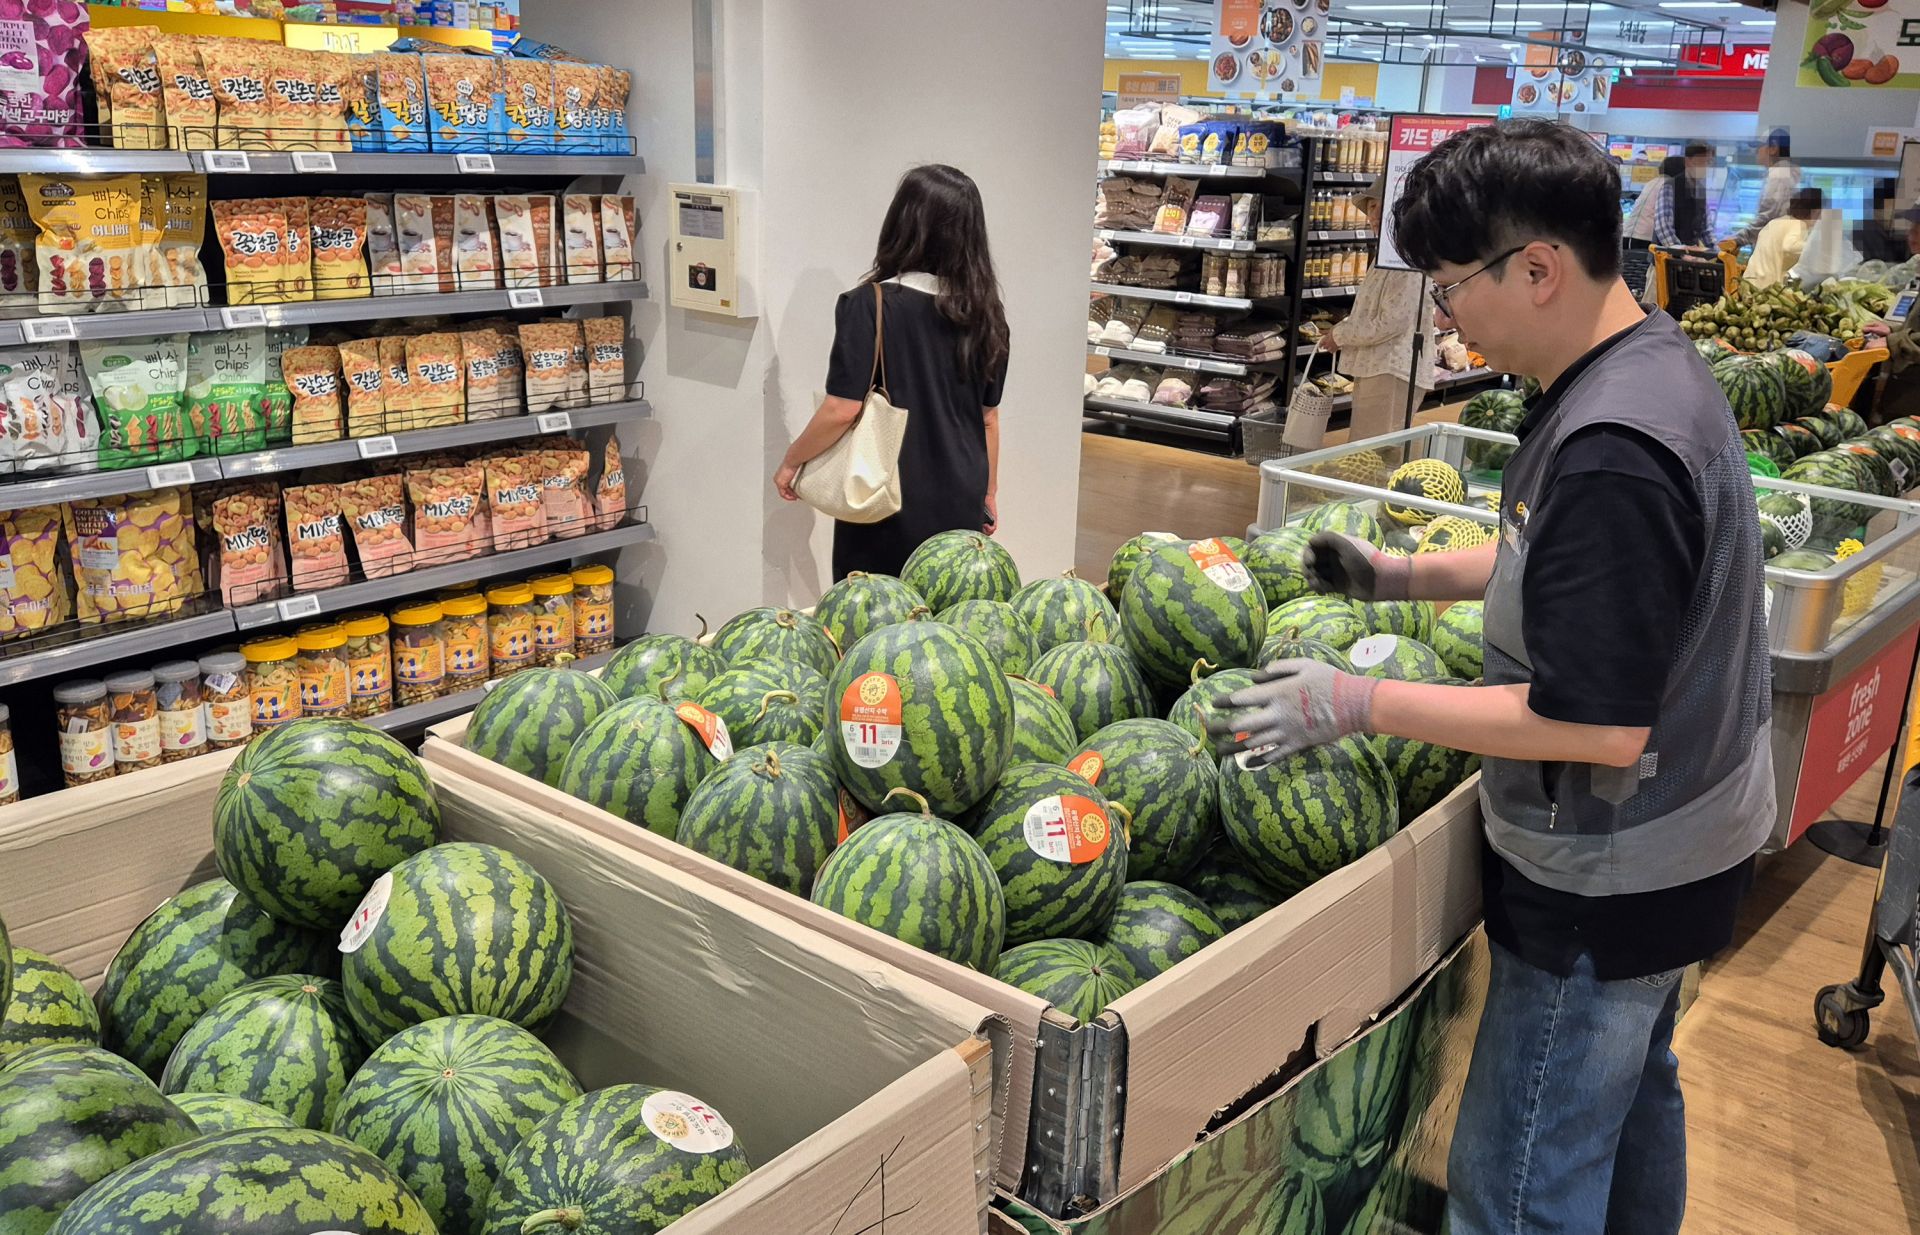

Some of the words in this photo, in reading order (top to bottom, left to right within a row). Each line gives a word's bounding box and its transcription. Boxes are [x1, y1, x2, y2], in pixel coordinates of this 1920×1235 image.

[222, 77, 265, 100] 칼몬드
[275, 79, 317, 103] 칼몬드
[434, 100, 488, 126] 칼땅콩
[505, 103, 549, 128] 칼땅콩
[1400, 127, 1428, 146] 카드
[92, 187, 131, 207] 빠삭
[95, 207, 129, 223] Chips
[214, 342, 252, 360] 빠삭
[20, 352, 61, 372] 빠삭
[214, 360, 250, 372] Chips
[219, 373, 248, 382] Onion
[419, 363, 457, 383] 칼몬드
[295, 373, 337, 395] 칼몬드
[425, 496, 472, 517] MIX땅콩
[77, 521, 109, 529] POTATO
[1848, 665, 1881, 718] fresh
[859, 723, 877, 745] 11
[1844, 703, 1874, 745] zone
[1046, 816, 1066, 837] 11
